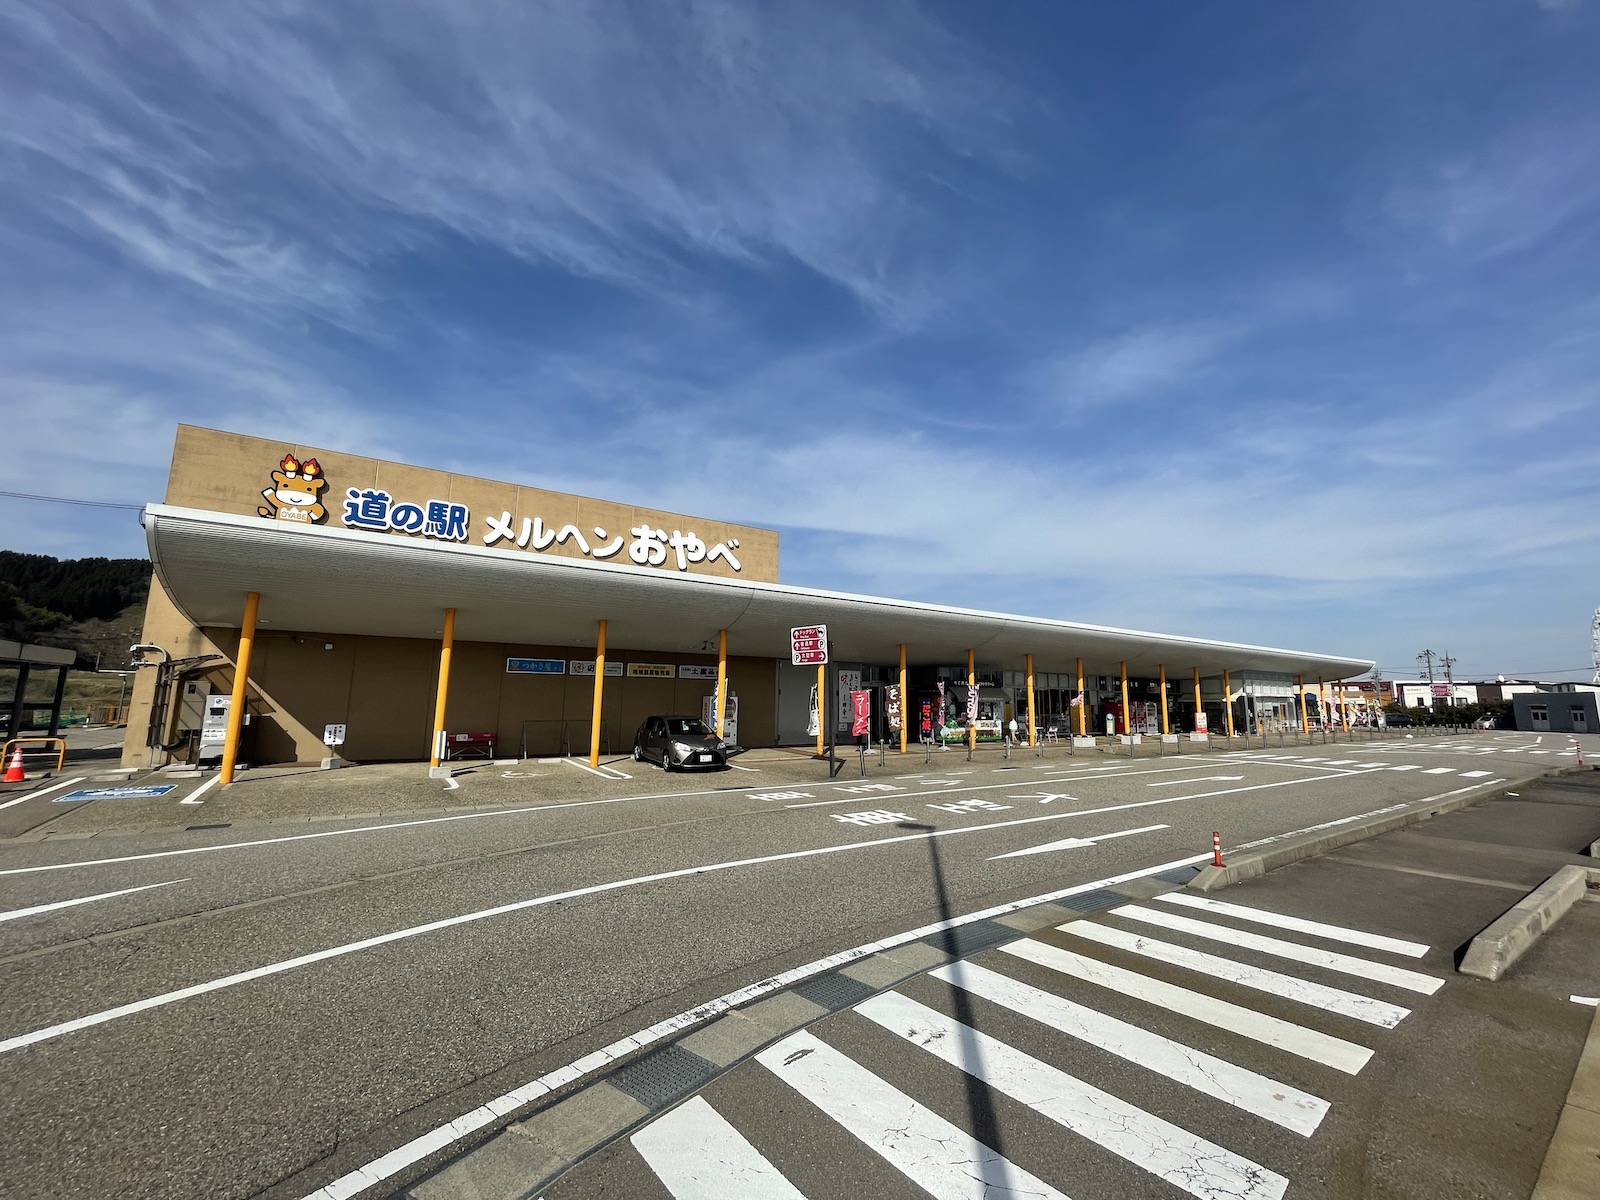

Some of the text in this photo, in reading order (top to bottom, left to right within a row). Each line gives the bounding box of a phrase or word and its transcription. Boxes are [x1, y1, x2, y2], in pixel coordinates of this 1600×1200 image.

[280, 510, 307, 521] OYABE
[342, 488, 742, 571] 道の駅 メルヘンおやべ
[855, 694, 865, 734] ラーメン
[888, 688, 901, 728] そば処
